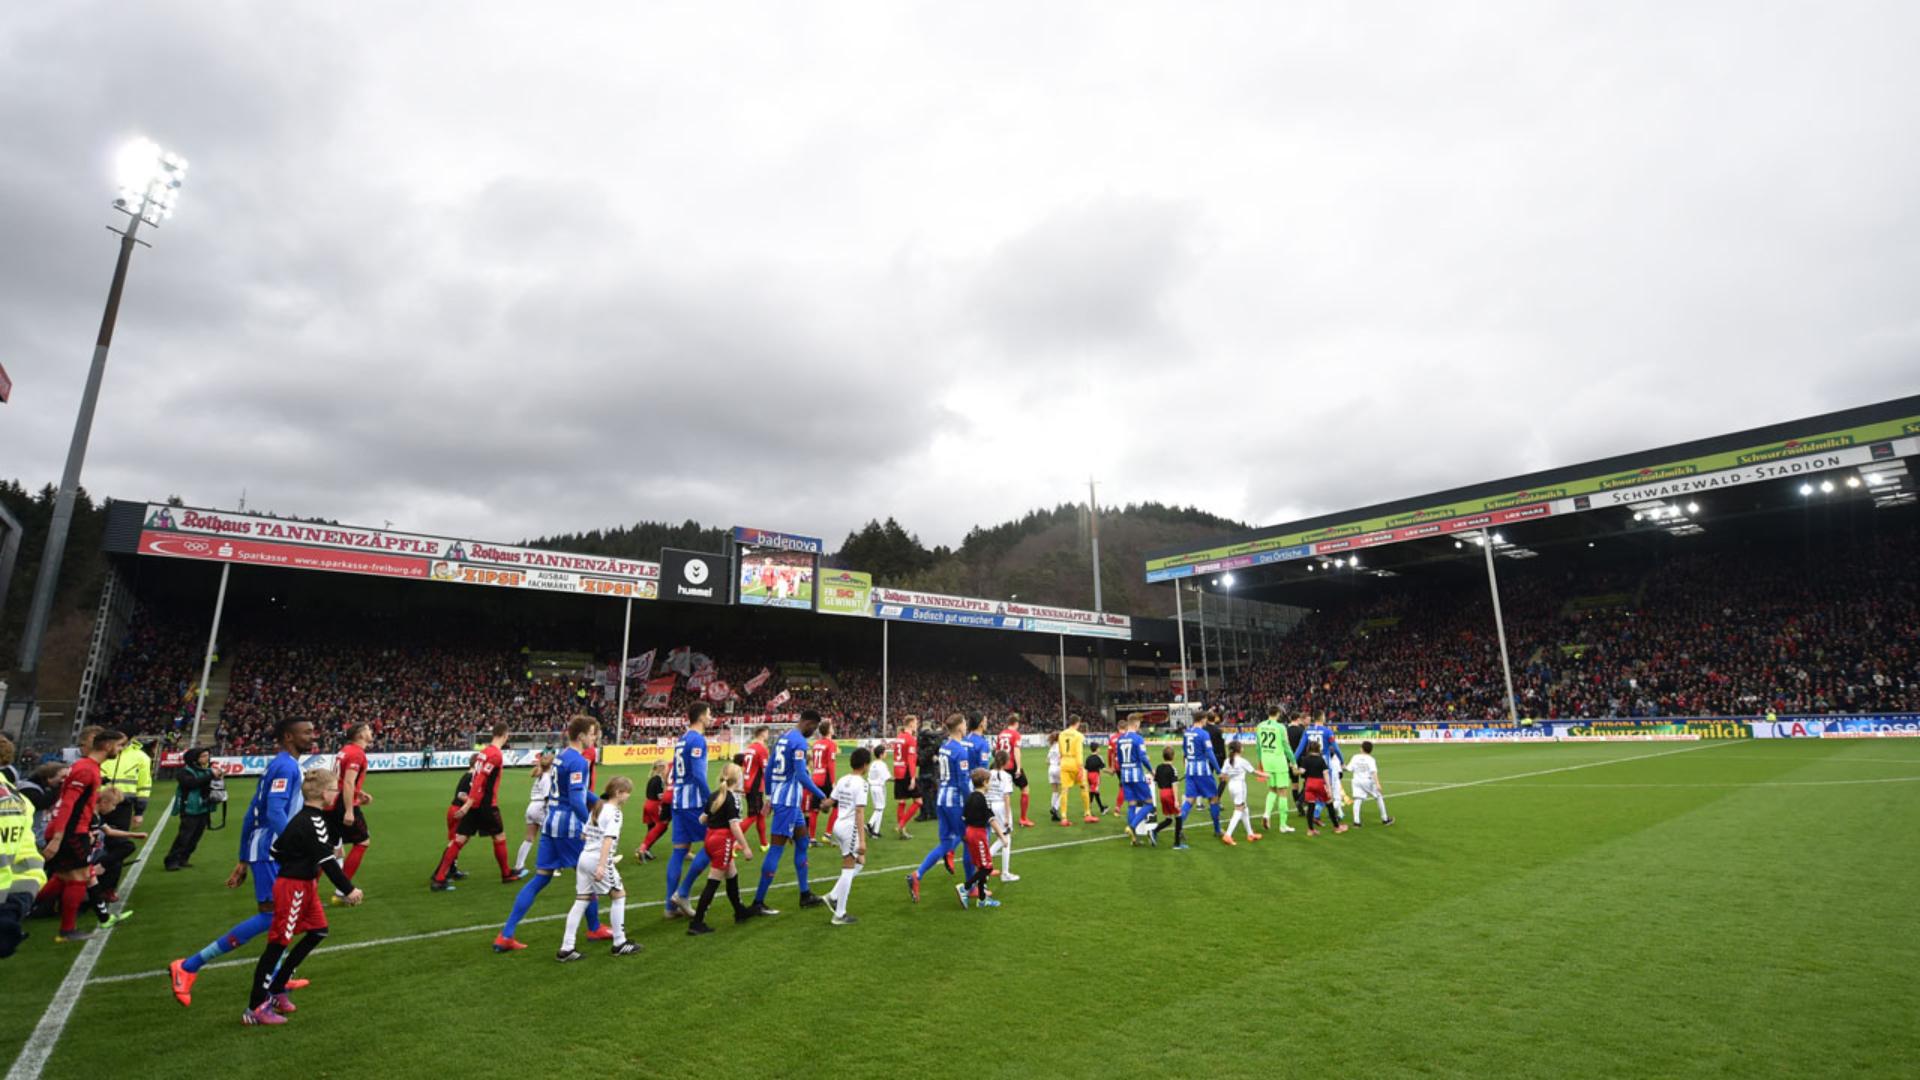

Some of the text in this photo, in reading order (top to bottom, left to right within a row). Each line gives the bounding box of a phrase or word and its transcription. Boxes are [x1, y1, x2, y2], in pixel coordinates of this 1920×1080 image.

[1740, 437, 1850, 464] Schwarzwaldmilch
[1601, 465, 1695, 488] Schwarzwaldmilch
[181, 510, 438, 554] Rothaus TANNENZÄPFLE
[758, 531, 817, 551] badenova
[238, 550, 423, 576] Sparkasse www.sparkasse-freiburg.de
[470, 544, 659, 577] Rothaus TANNENZÄPFLE
[463, 567, 520, 586] ZIPSE
[538, 572, 569, 582] AUSBAU
[583, 580, 633, 596] ZIPSE
[677, 584, 713, 597] hummel
[914, 594, 991, 611] TANNENZÄPFLE
[912, 608, 944, 621] Badisch
[944, 613, 958, 625] gut
[958, 614, 994, 626] versichert
[1261, 731, 1276, 749] 22
[1472, 728, 1545, 739] lactosefrei
[637, 746, 667, 756] LOTTO
[1064, 738, 1070, 753] 1
[1120, 743, 1132, 763] 17
[1186, 736, 1195, 755] 5
